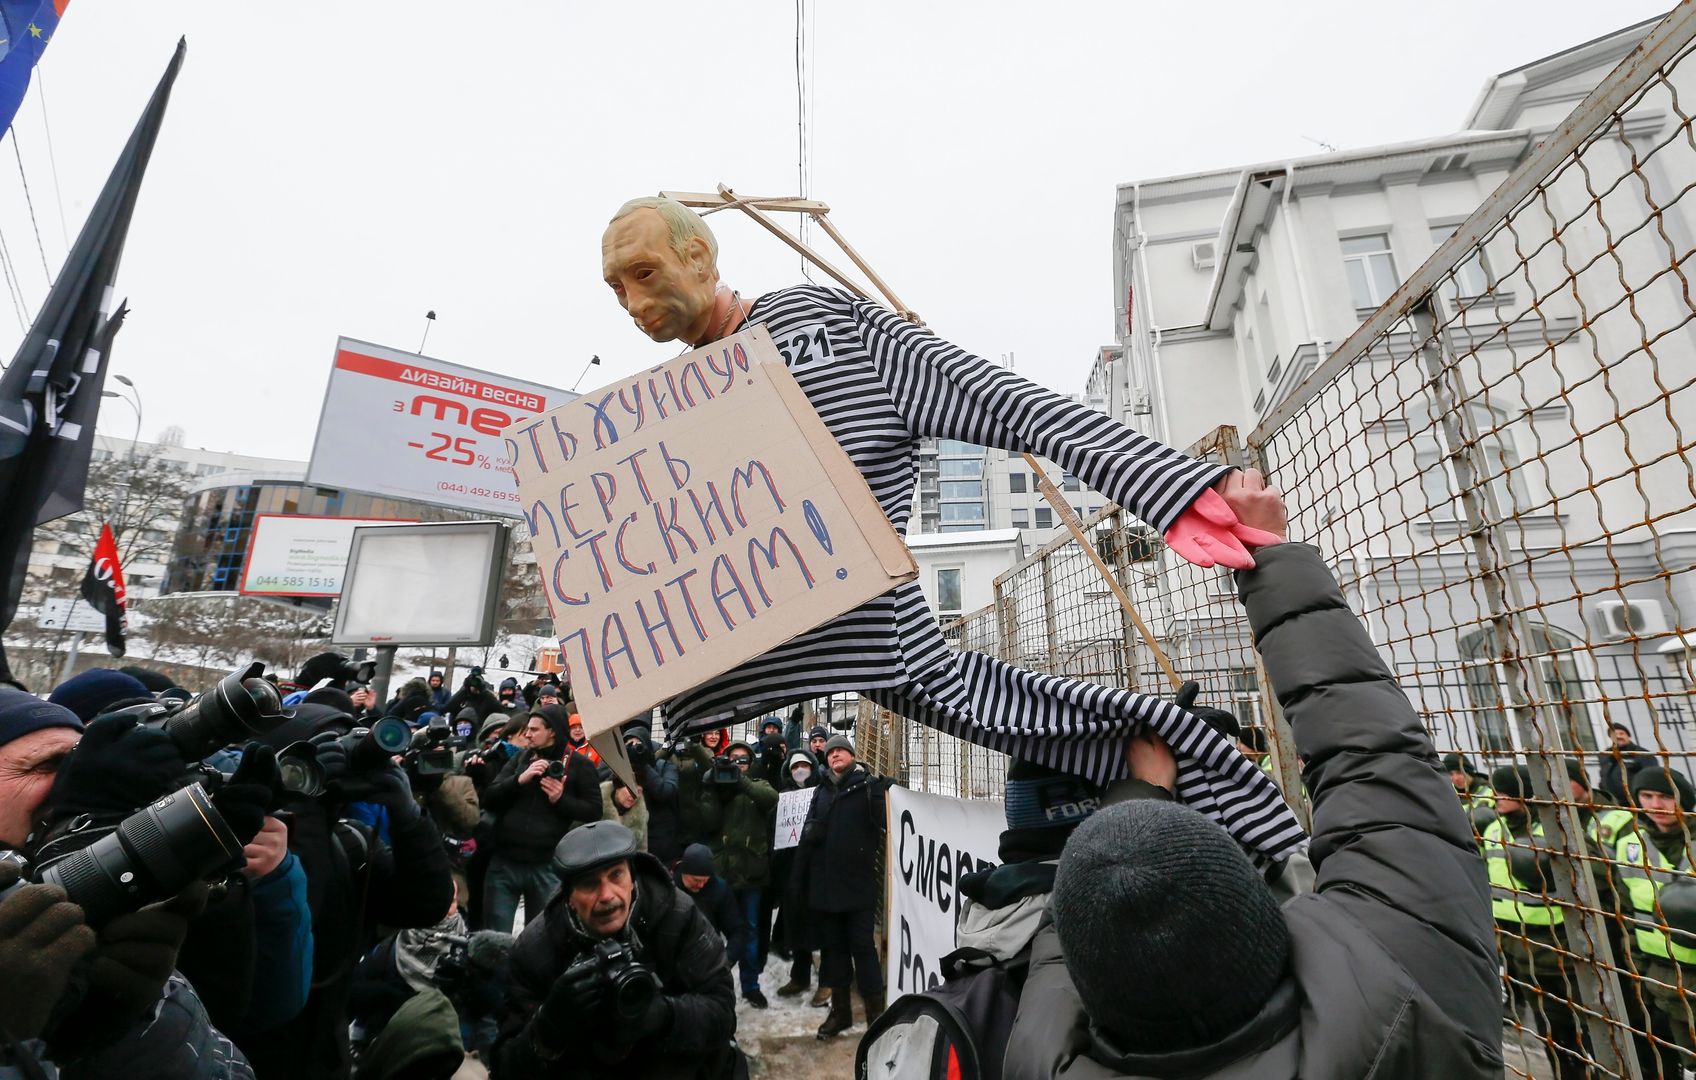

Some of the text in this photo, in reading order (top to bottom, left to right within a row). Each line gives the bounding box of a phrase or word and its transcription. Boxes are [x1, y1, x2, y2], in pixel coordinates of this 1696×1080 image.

[776, 328, 830, 367] 521
[481, 386, 538, 409] весна
[410, 395, 528, 437] me
[437, 481, 468, 494] (044)
[470, 487, 491, 498] 492
[493, 490, 506, 501] 69
[256, 576, 335, 588] 044 585 15 15
